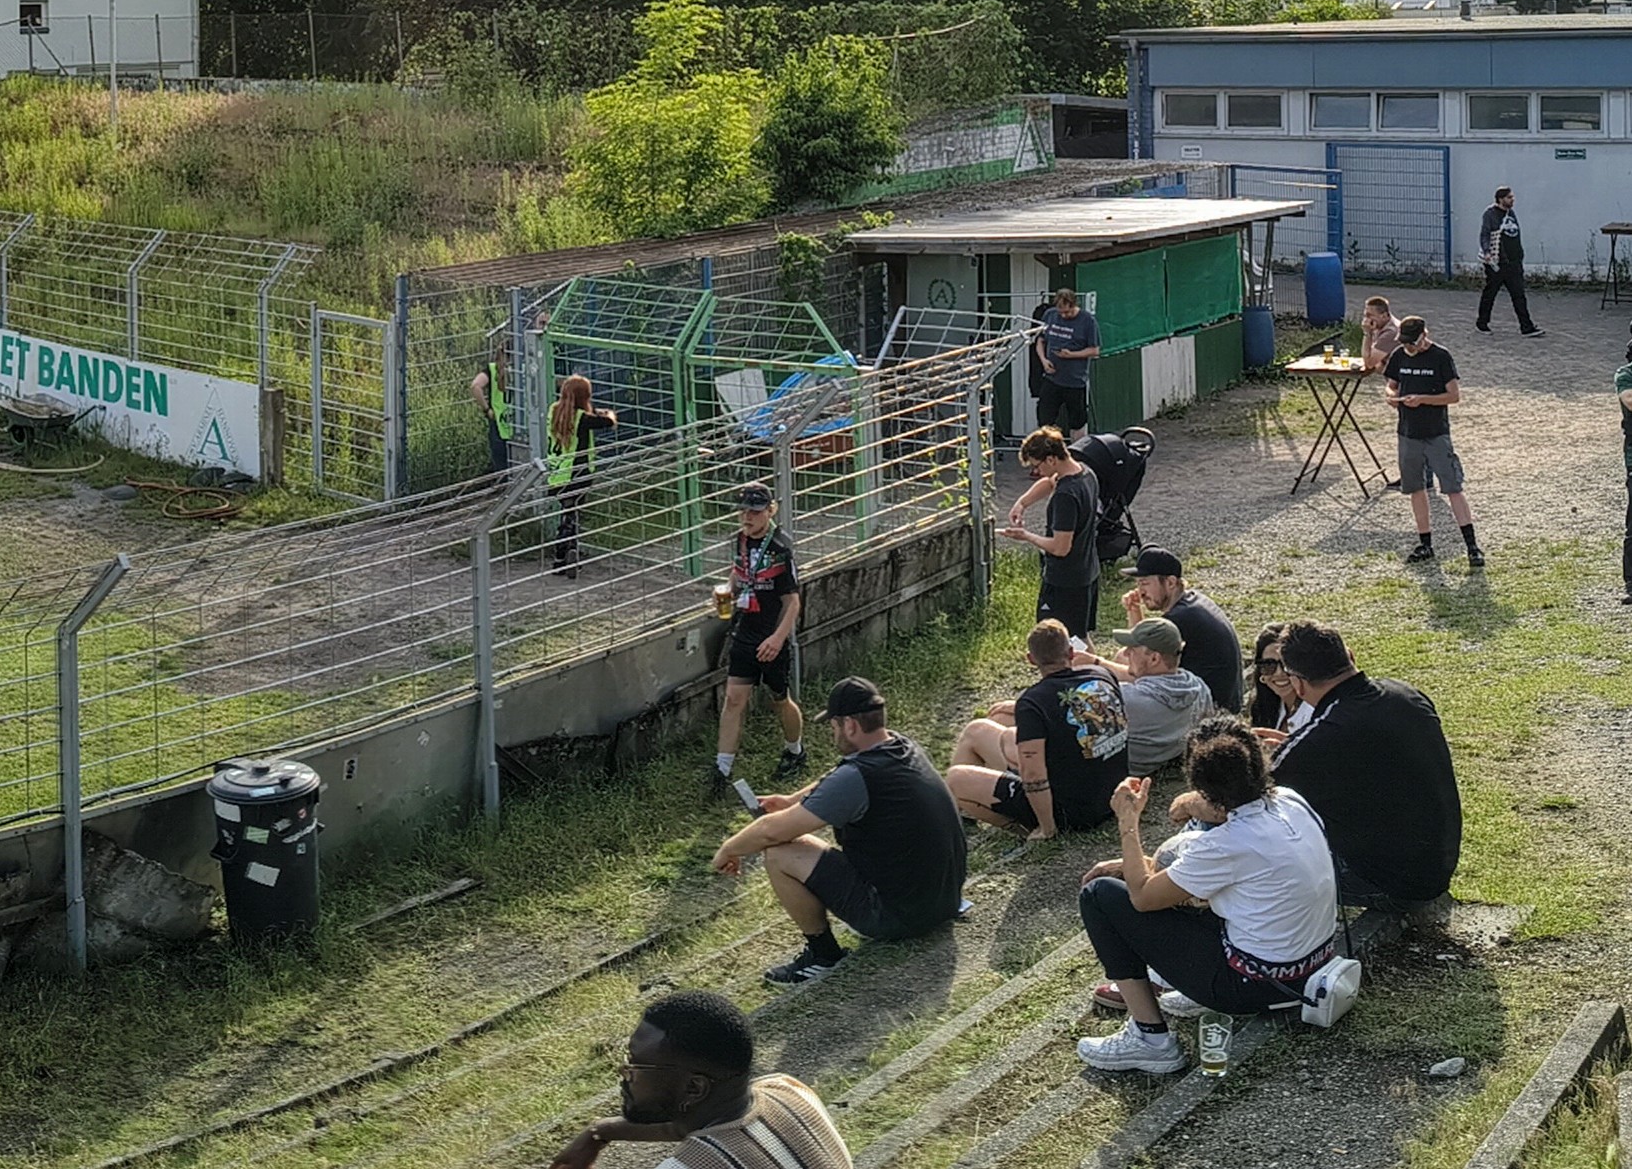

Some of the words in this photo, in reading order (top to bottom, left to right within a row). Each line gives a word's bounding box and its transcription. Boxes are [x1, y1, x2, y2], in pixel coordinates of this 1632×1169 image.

[37, 344, 170, 418] BANDEN
[196, 416, 233, 462] A
[1235, 952, 1309, 981] TOMMY
